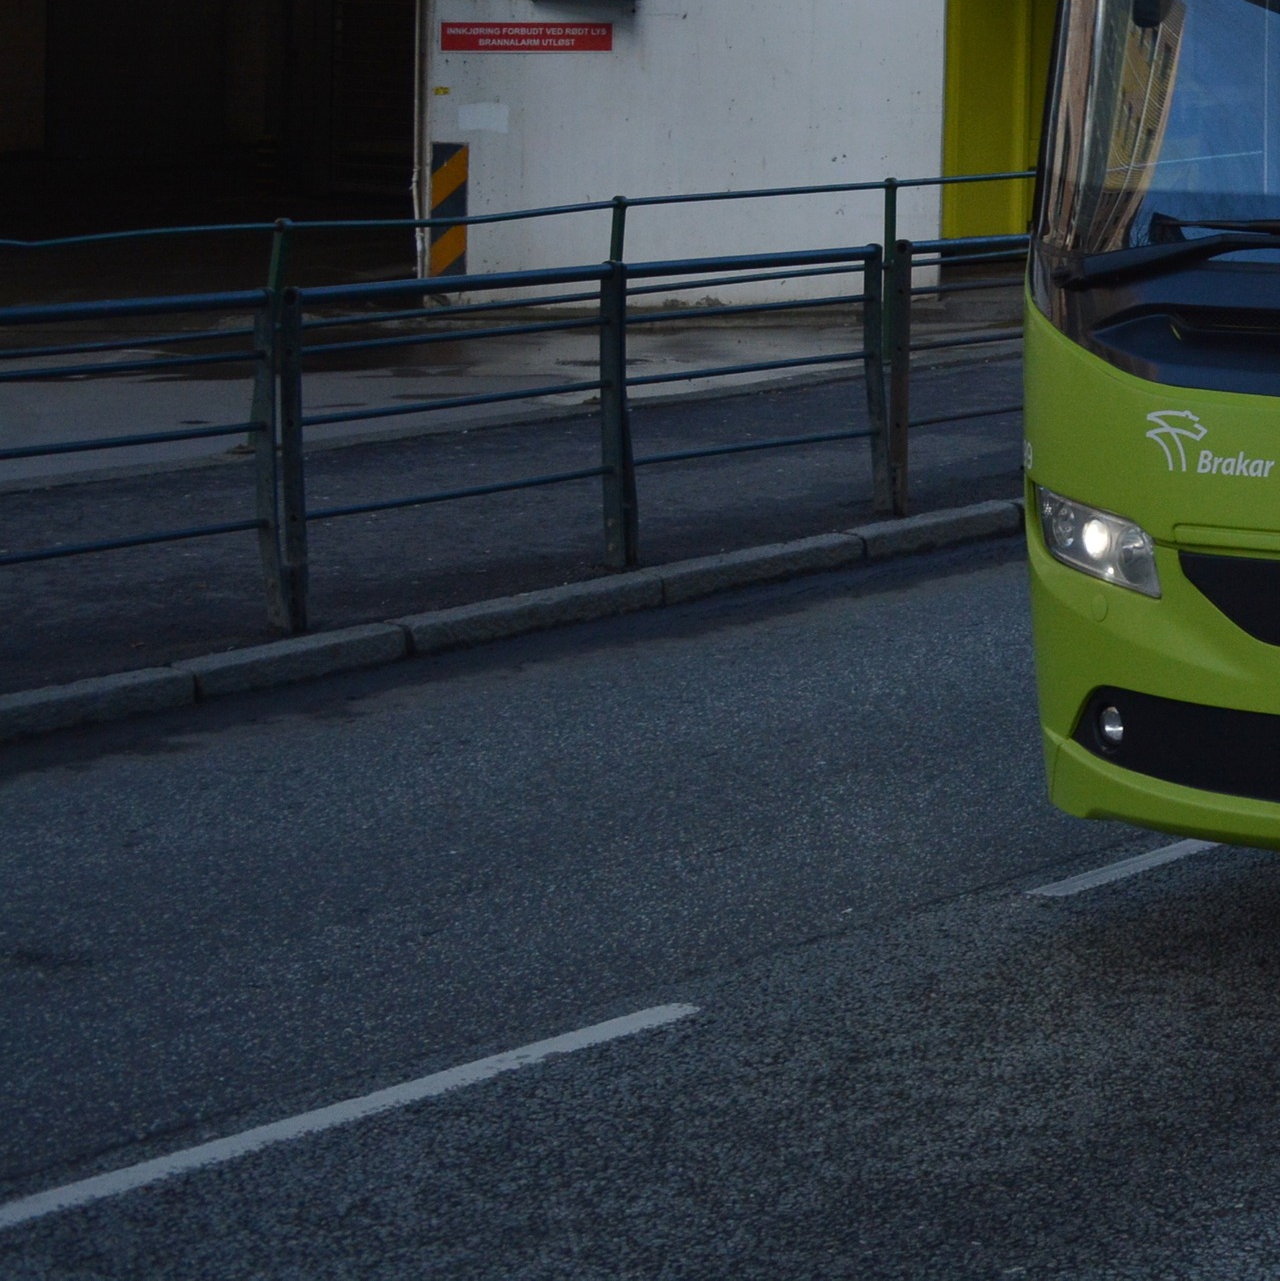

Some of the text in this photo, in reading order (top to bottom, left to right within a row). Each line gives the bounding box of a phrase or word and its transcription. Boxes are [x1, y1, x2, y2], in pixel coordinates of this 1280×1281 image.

[446, 27, 607, 36] INNKJØRING FORBUDT VED RØDT LYS
[478, 38, 576, 47] BRANNALARM UTLØST
[1197, 450, 1275, 478] Brakar
